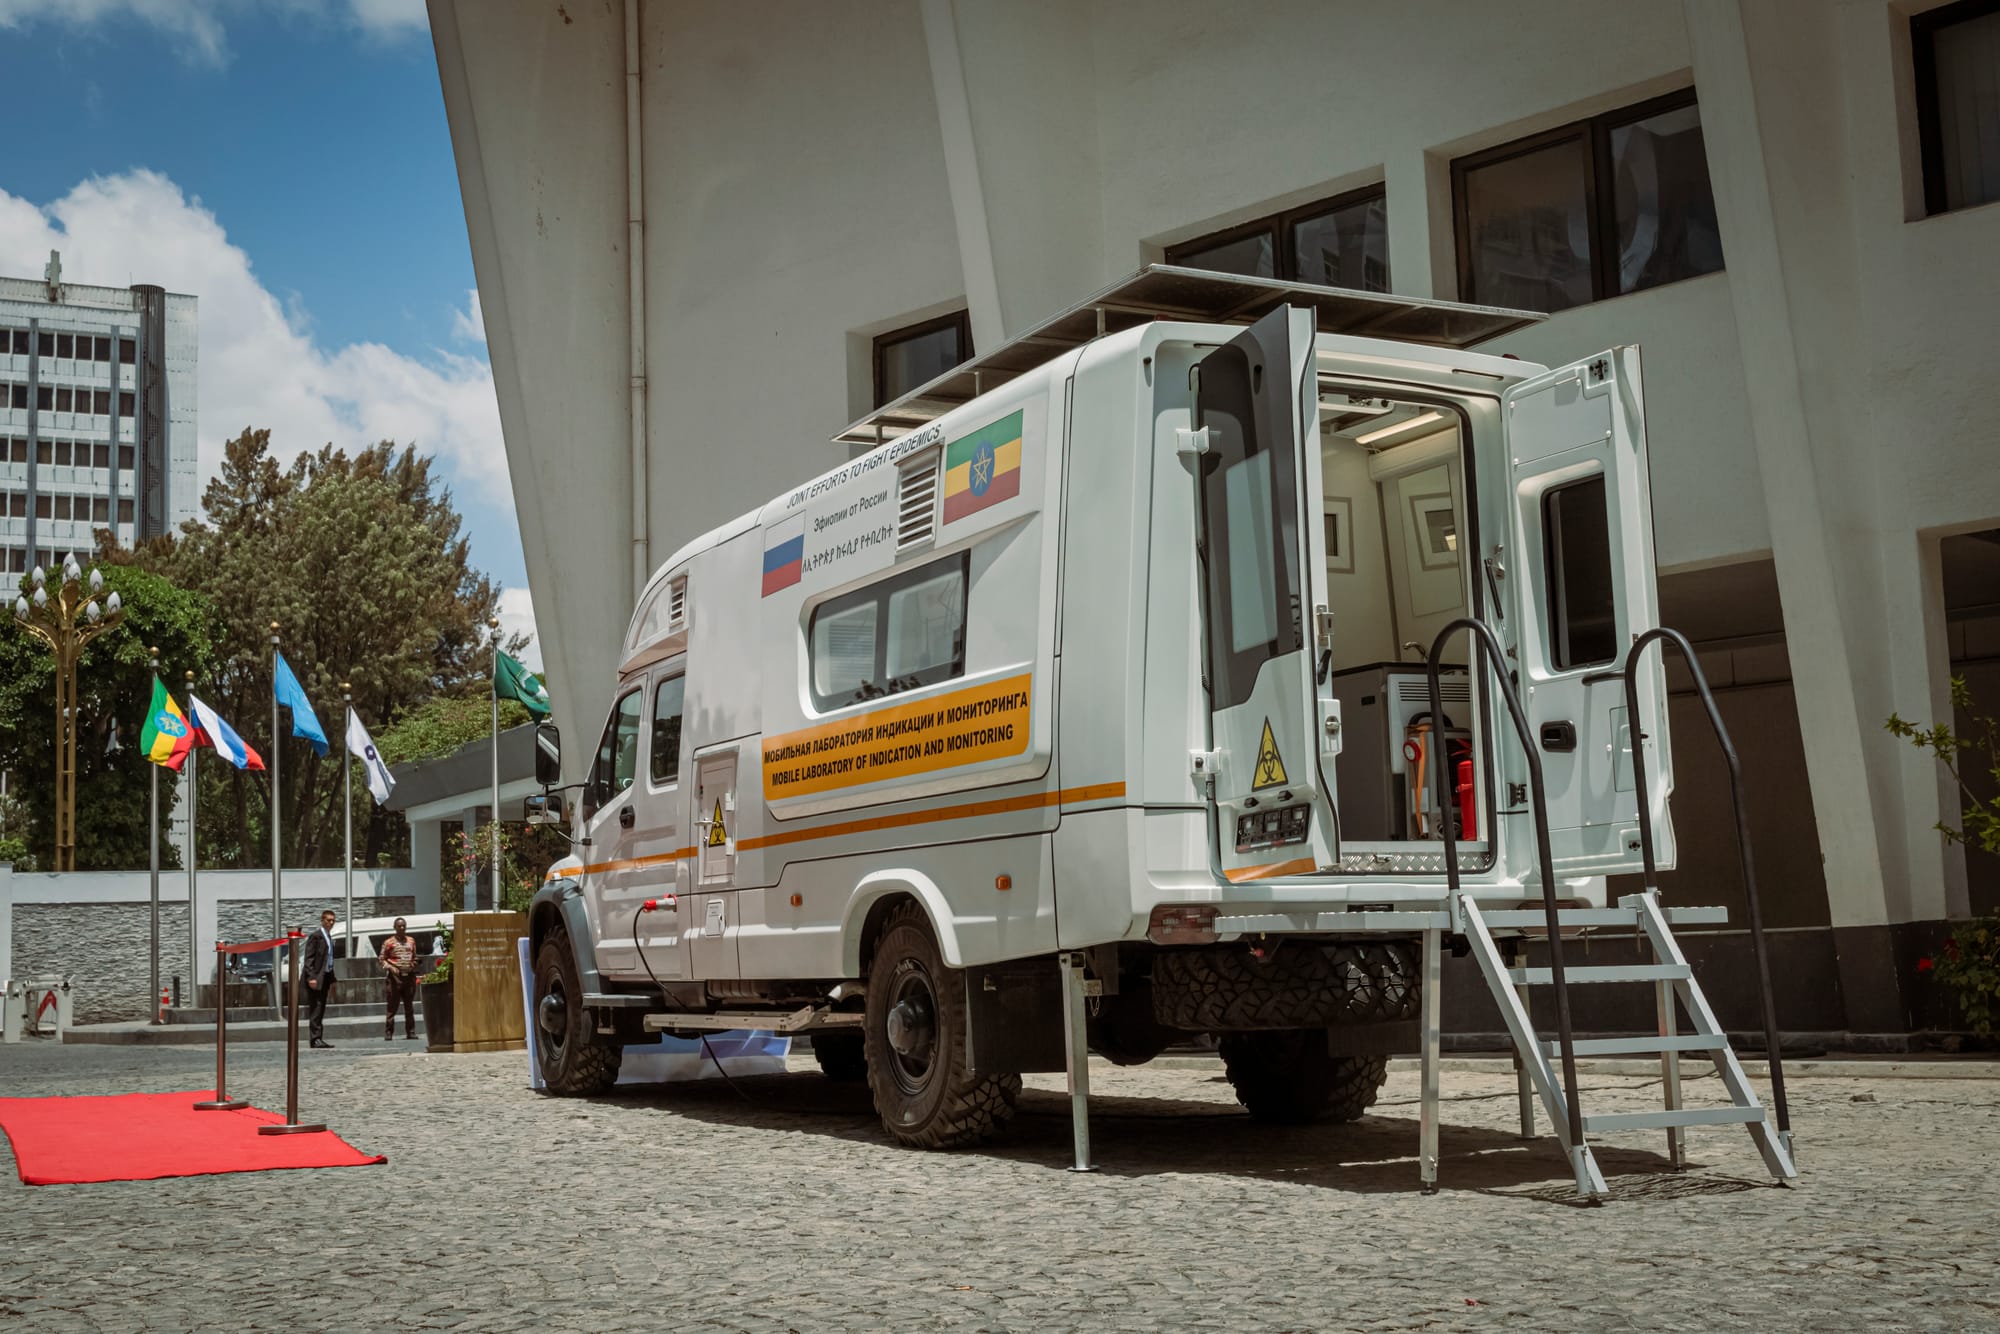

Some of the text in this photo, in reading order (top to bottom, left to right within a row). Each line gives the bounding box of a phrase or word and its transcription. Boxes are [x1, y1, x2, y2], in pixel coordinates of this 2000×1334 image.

[787, 424, 942, 509] JOINT EFFORTS TO FIGHT EPIDEMICS
[813, 490, 888, 533] Эфиопии от России
[764, 691, 1028, 764] МОБИЛЬНАЯ ЛАБОРАТОРИЯ ИНДИКАЦИИ И МОНИТОРИНГА
[772, 724, 1014, 786] MOBILE LABORATORY OF INDICATION AND MONITORING
